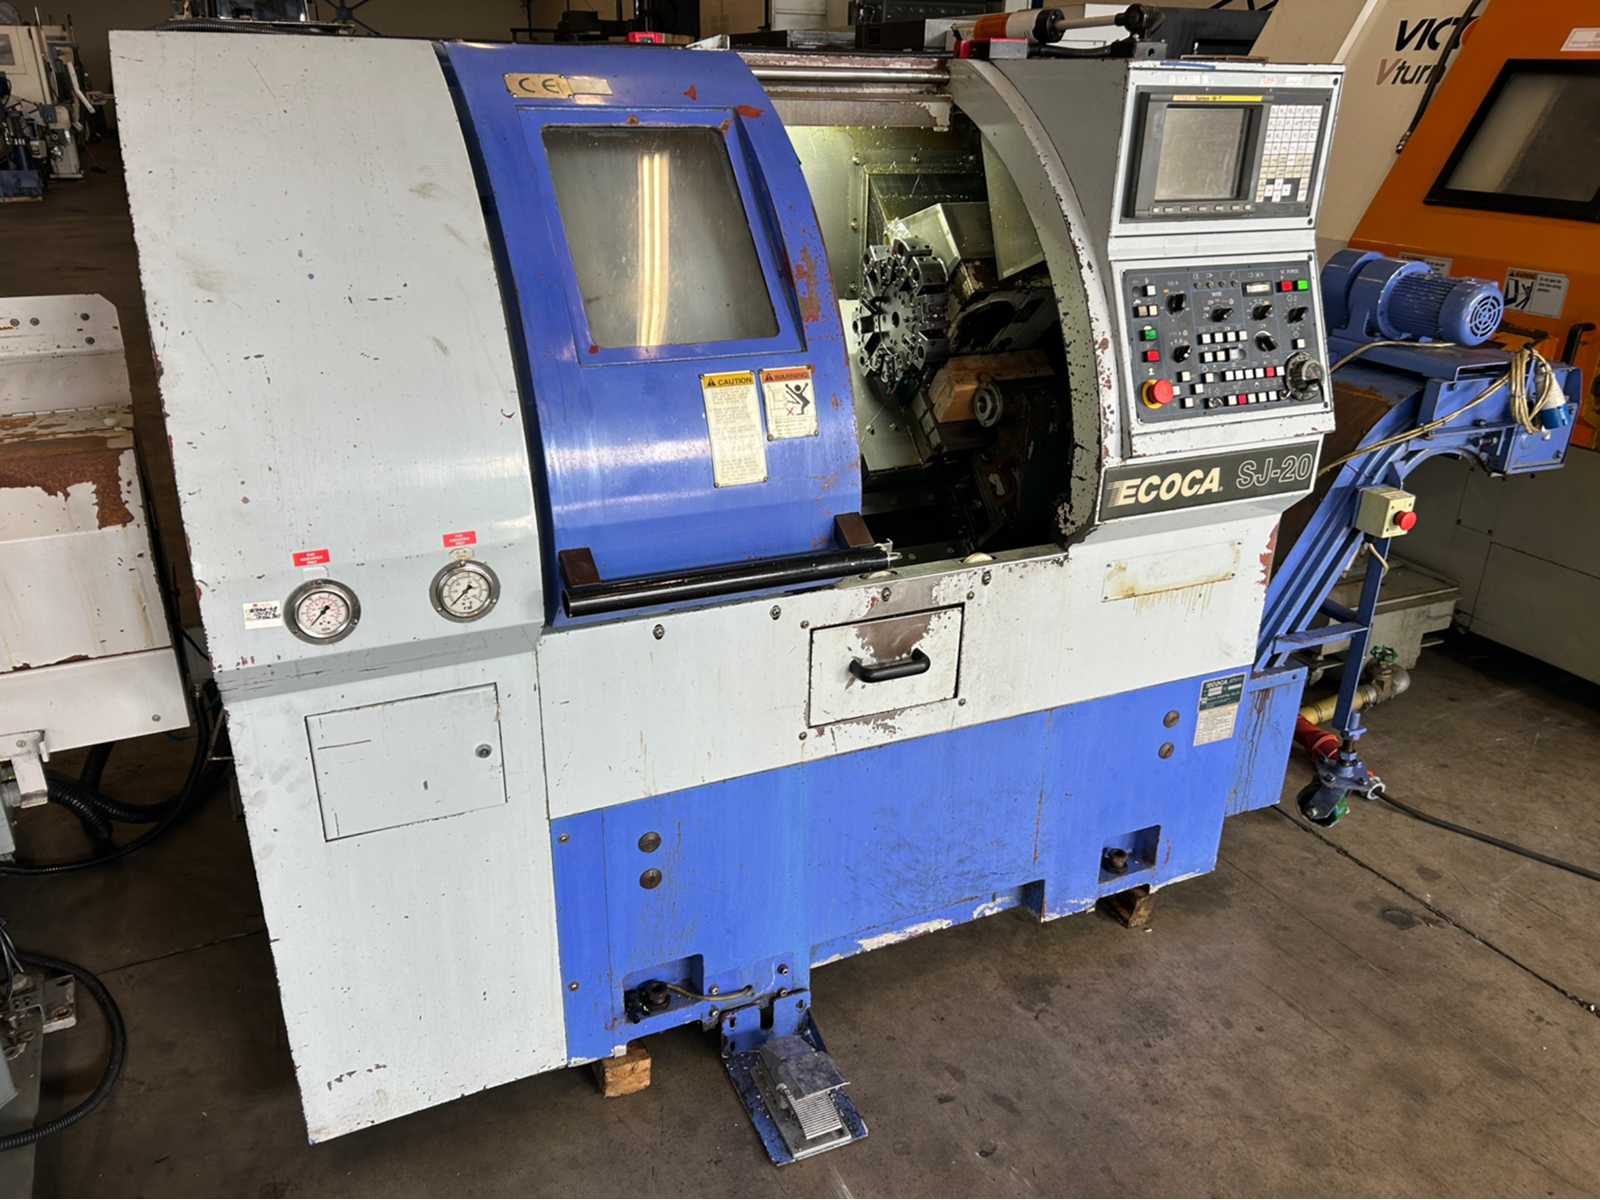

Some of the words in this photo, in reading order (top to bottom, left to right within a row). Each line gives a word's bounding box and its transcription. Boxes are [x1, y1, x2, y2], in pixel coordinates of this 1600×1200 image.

[1395, 15, 1481, 52] VICT
[518, 77, 560, 94] CE
[718, 376, 753, 386] CAUTION
[1112, 467, 1222, 507] ECOCA
[1235, 452, 1314, 489] SJ-20
